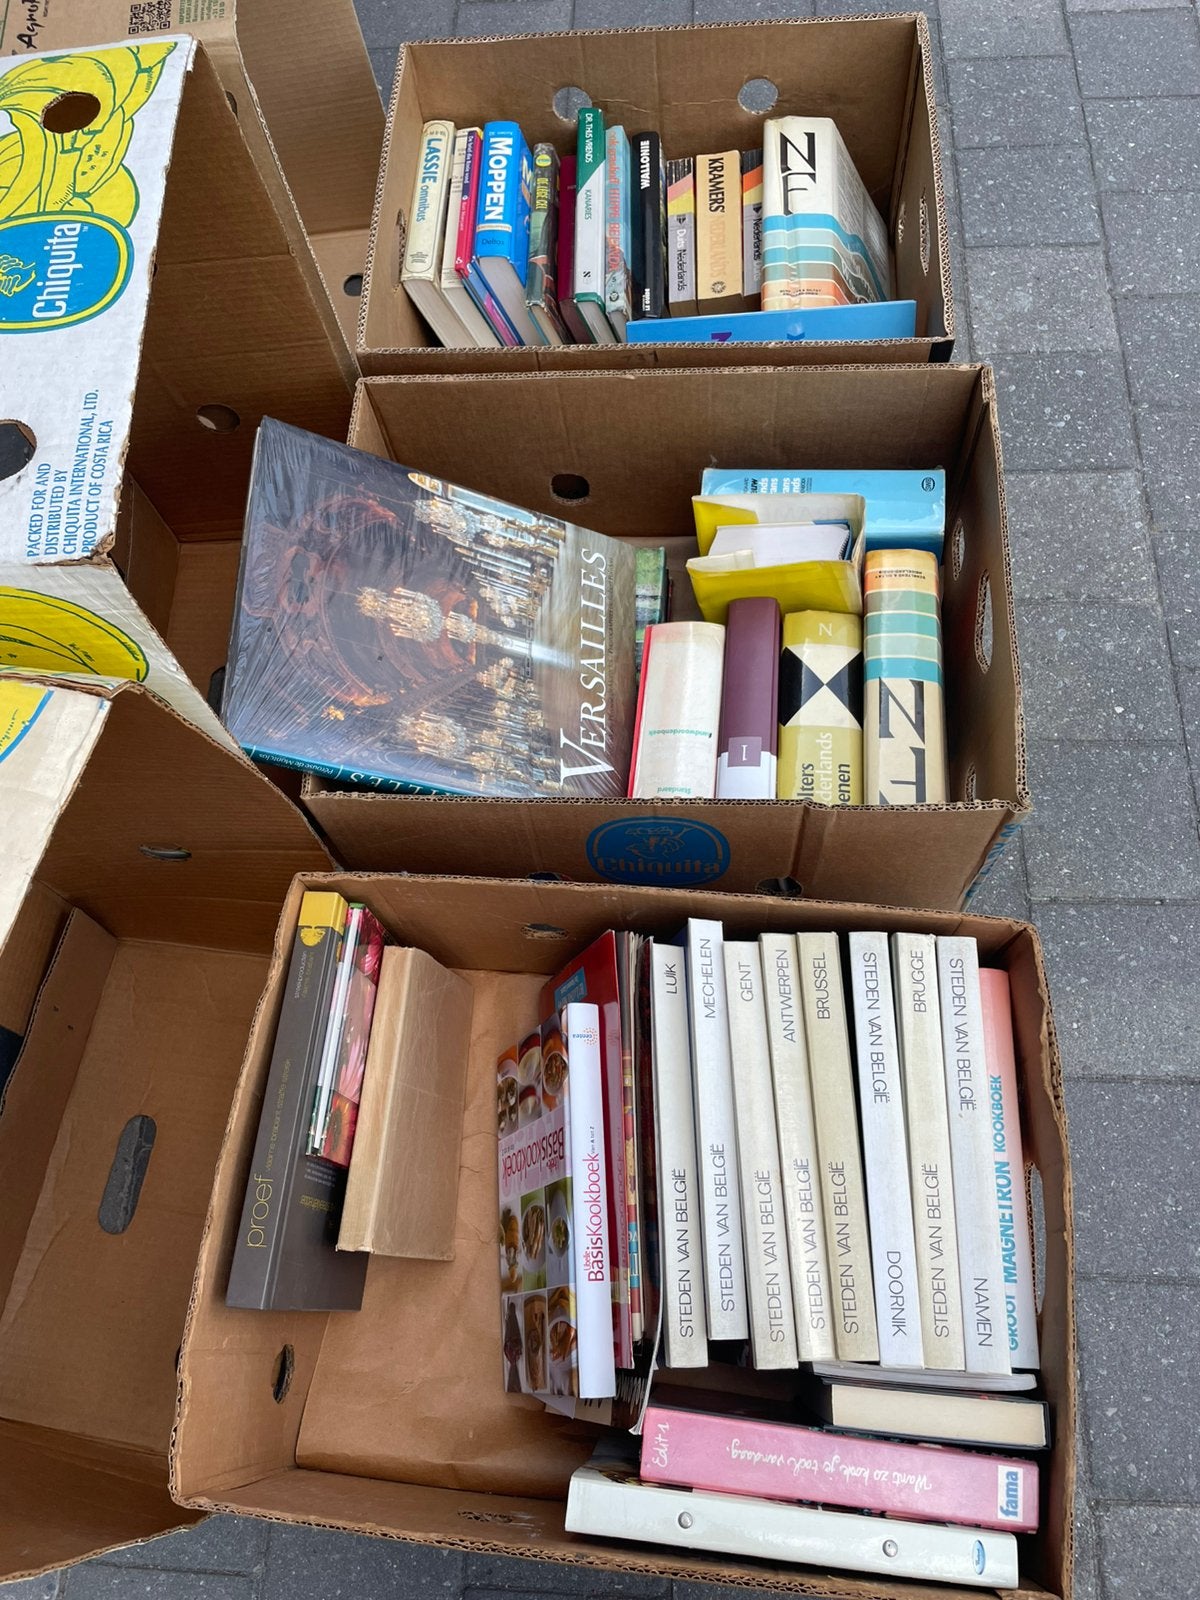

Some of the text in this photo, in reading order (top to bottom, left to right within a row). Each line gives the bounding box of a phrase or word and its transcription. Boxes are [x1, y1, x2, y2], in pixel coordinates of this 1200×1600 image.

[422, 138, 442, 183] LASSIE
[485, 137, 513, 221] MOPPEN
[640, 140, 649, 190] WALLONIE
[416, 185, 430, 222] omnibus
[584, 189, 592, 220] KANARIES
[753, 217, 762, 261] Nederlands
[32, 223, 83, 318] Chiquita
[677, 249, 687, 292] Nederlands
[63, 389, 99, 555] CHIQUITA INTERNATIONAL, LTD.
[81, 420, 113, 553] PRODUCT OF COSTA RICA
[27, 463, 51, 557] PACKED FOR AND
[44, 469, 68, 555] DISTRIBUTED BY
[560, 548, 614, 786] VERSAILLES
[304, 762, 333, 774] Pérouse
[657, 786, 692, 794] Standaard
[596, 857, 721, 877] Chiquita
[700, 938, 716, 1019] MECHELEN
[738, 962, 754, 1001] GENT
[776, 949, 796, 1043] ANTWERPEN
[813, 952, 830, 1019] BRUSSEL
[863, 952, 880, 1010] STEDEN
[911, 950, 927, 1013] BRUGGE
[950, 958, 967, 1017] STEDEN
[868, 1016, 883, 1046] VAN
[954, 1022, 969, 1053] VAN
[247, 1174, 274, 1248] proef
[716, 1203, 730, 1237] VAN
[990, 1074, 1019, 1351] GROOT MAGNETRON KOOKBOEK
[676, 1228, 690, 1262] VAN
[762, 1231, 778, 1266] VAN
[803, 1219, 818, 1254] VAN
[836, 1222, 852, 1257] VAN
[928, 1226, 944, 1260] VAN
[718, 1243, 735, 1312] STEDEN
[806, 1260, 825, 1329] STEDEN
[839, 1264, 859, 1334] STEDEN
[887, 1251, 907, 1337] DOORNIK
[678, 1269, 693, 1338] STEDEN
[765, 1272, 785, 1342] STEDEN
[931, 1267, 950, 1337] STEDEN
[973, 1277, 993, 1346] NAMEN
[652, 1435, 669, 1468] Edit
[787, 1456, 819, 1476] toch
[823, 1455, 840, 1480] je
[839, 1464, 870, 1486] kook
[873, 1468, 890, 1482] zo
[893, 1472, 933, 1493] Want
[1000, 1471, 1019, 1518] fama
